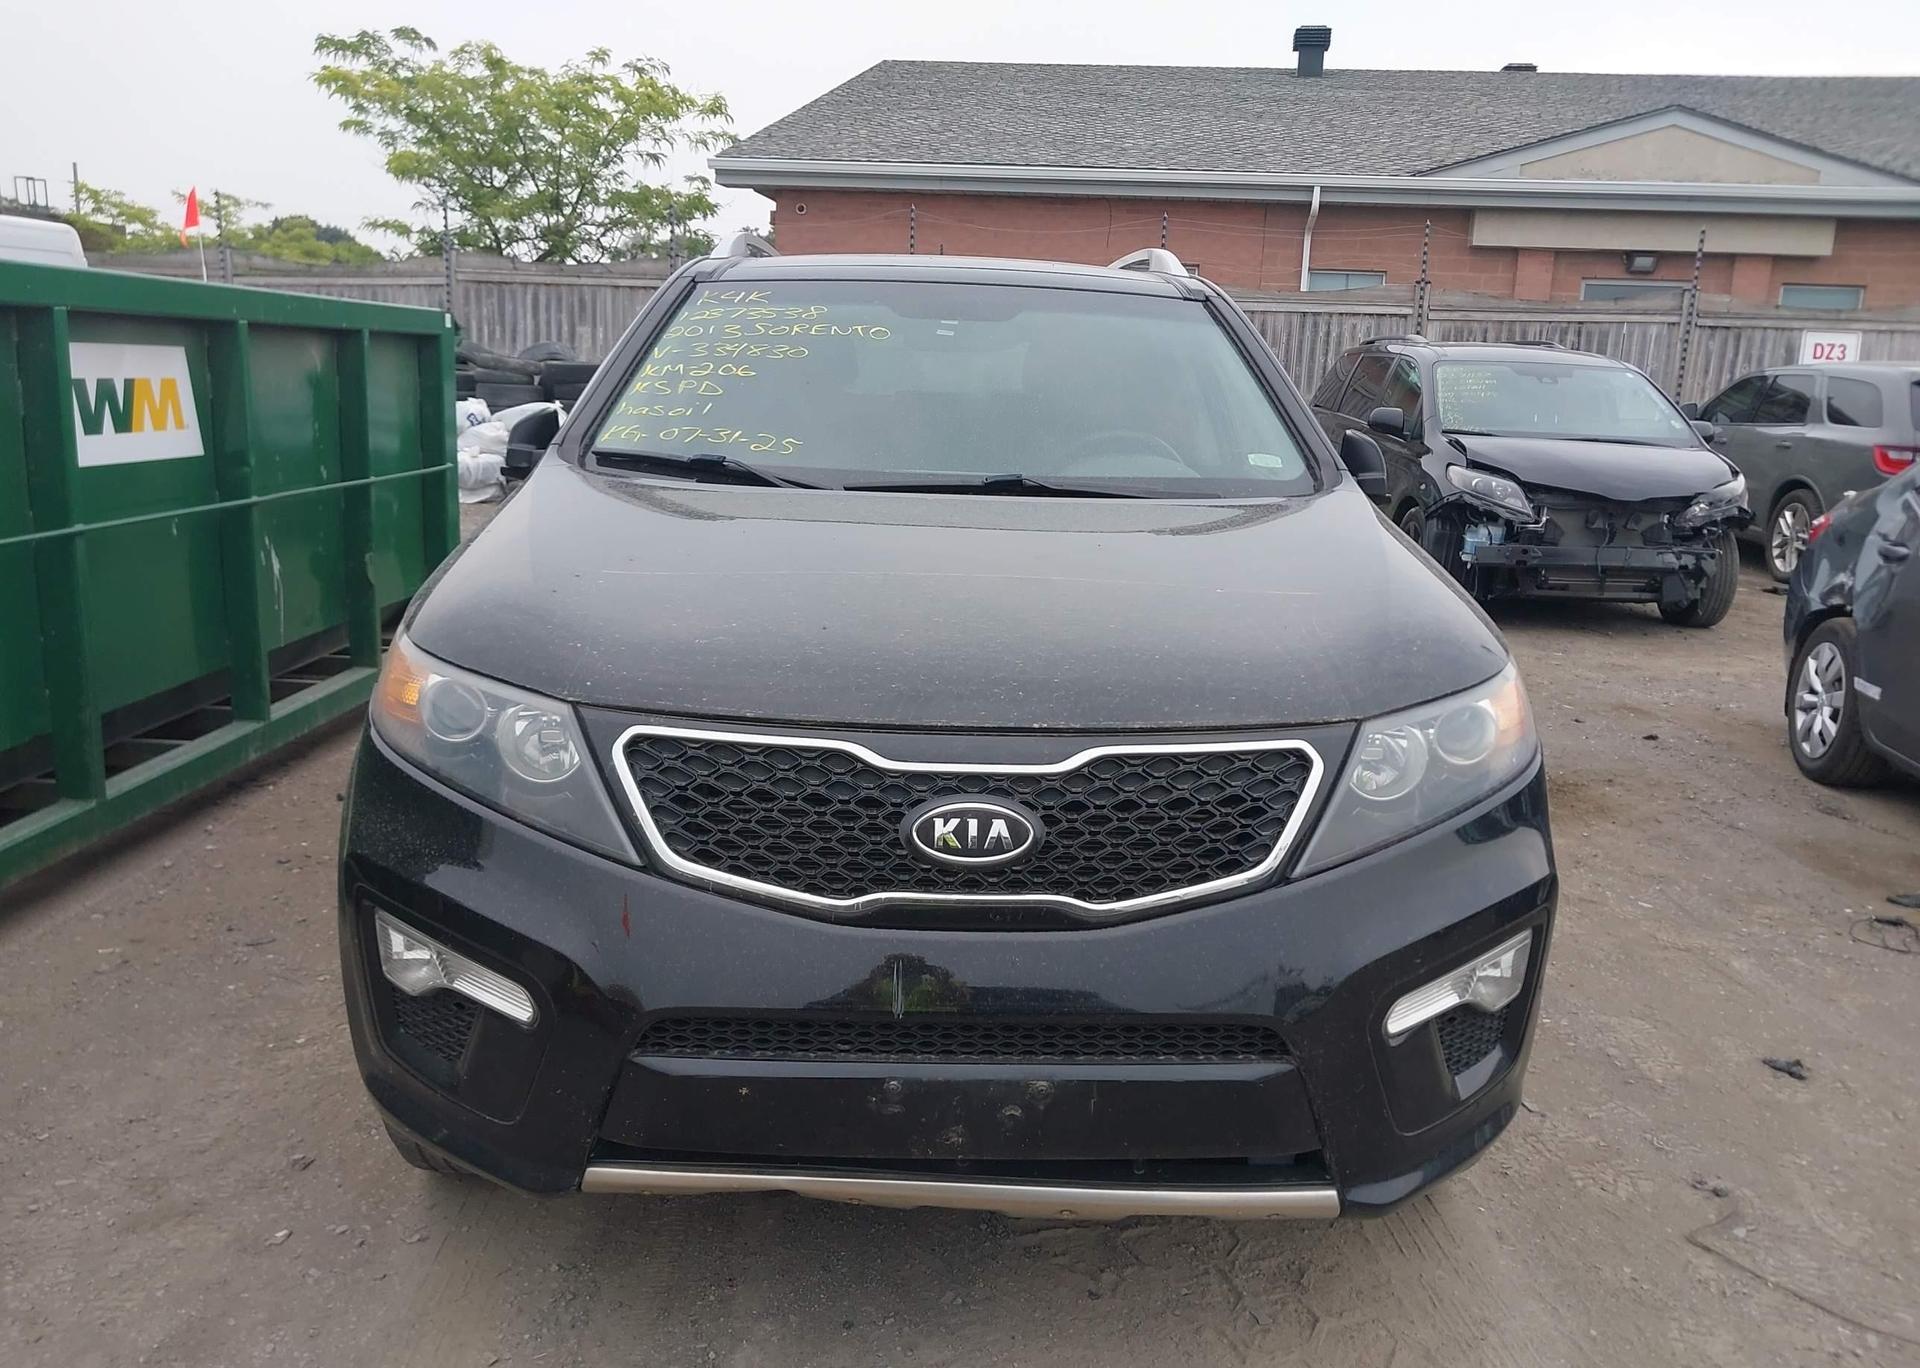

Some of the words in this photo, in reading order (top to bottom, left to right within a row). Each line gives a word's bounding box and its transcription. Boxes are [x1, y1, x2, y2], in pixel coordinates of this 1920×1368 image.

[696, 290, 772, 306] K4K
[663, 324, 743, 339] 2013
[743, 322, 892, 341] SORENTO
[1812, 342, 1847, 361] DZ3
[71, 377, 185, 436] WM
[659, 426, 804, 454] 07-31-25
[932, 817, 1015, 850] KIA
